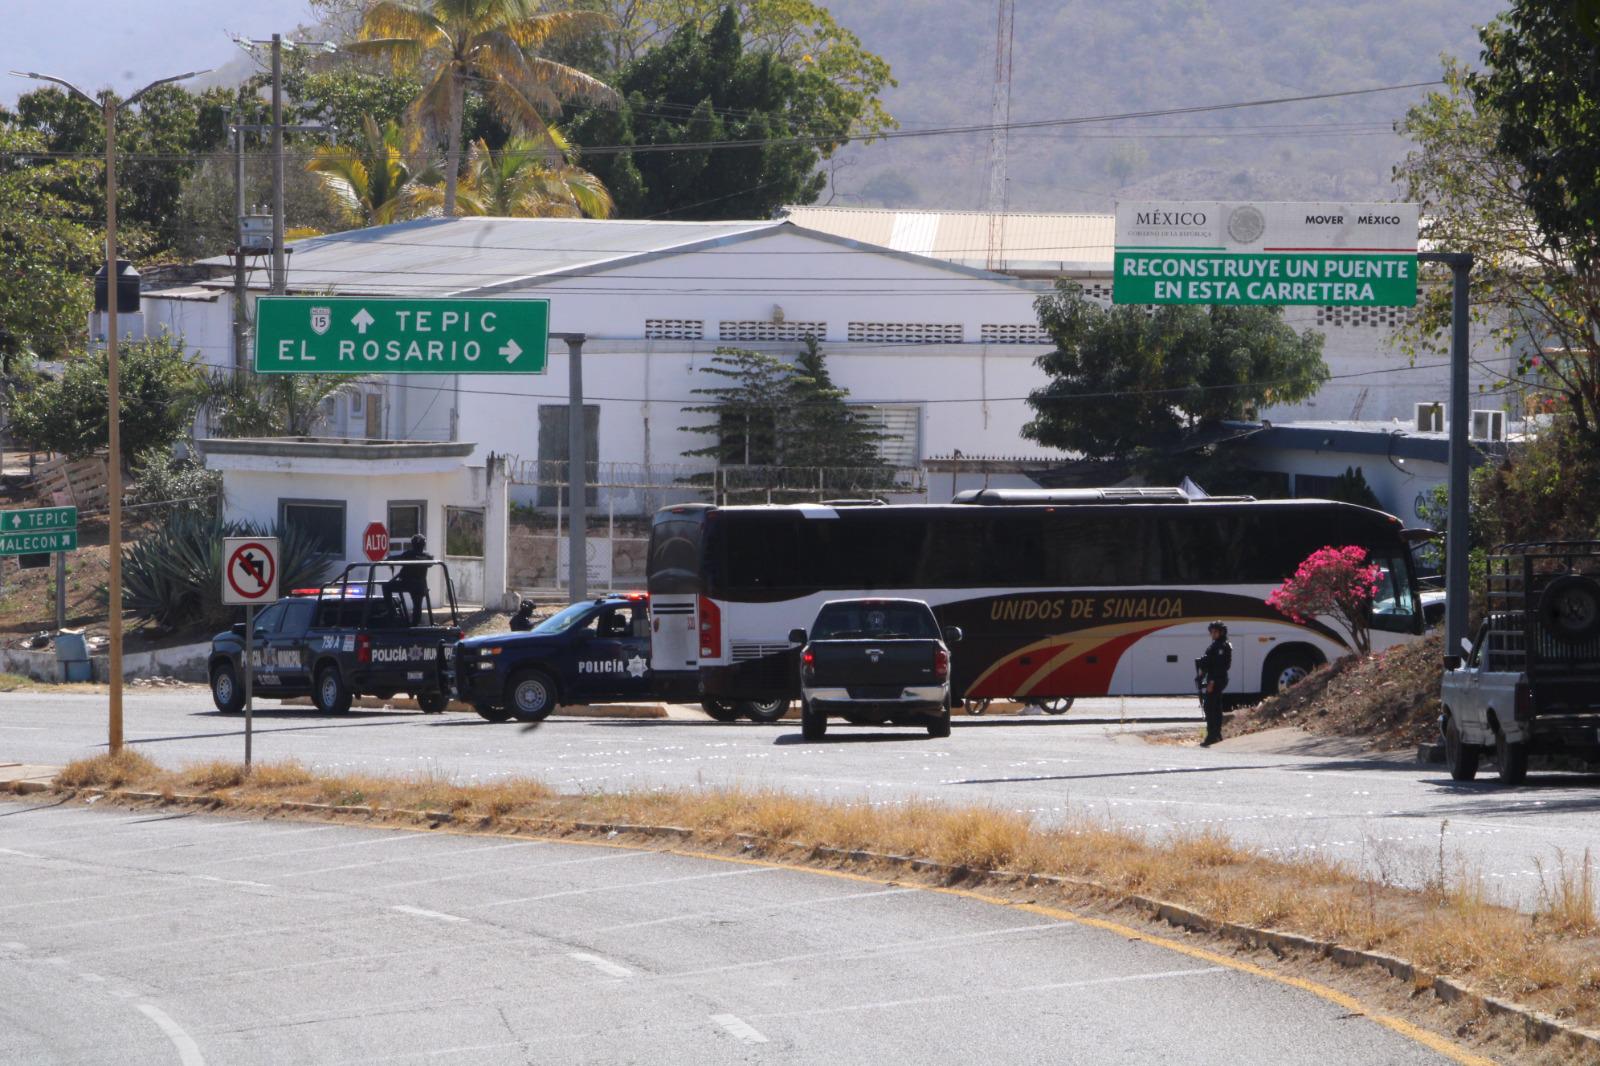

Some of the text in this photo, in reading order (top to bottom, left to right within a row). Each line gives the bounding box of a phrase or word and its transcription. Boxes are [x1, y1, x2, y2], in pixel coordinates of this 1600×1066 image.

[1136, 209, 1206, 225] MÉXICO
[1305, 213, 1400, 225] MOVER MÉXICO
[1123, 258, 1408, 278] RECONSTRUYE UN PUENTE
[1154, 281, 1375, 300] EN ESTA CARRETERA
[315, 316, 327, 328] 15
[395, 311, 497, 332] TEPIC
[278, 340, 481, 361] EL ROSARIO
[29, 512, 68, 526] TEPIC
[366, 534, 387, 551] ALTO
[990, 598, 1182, 620] UNIDOS DE SINALOA
[371, 646, 408, 662] POLICÍA
[578, 659, 625, 673] POLICÍA
